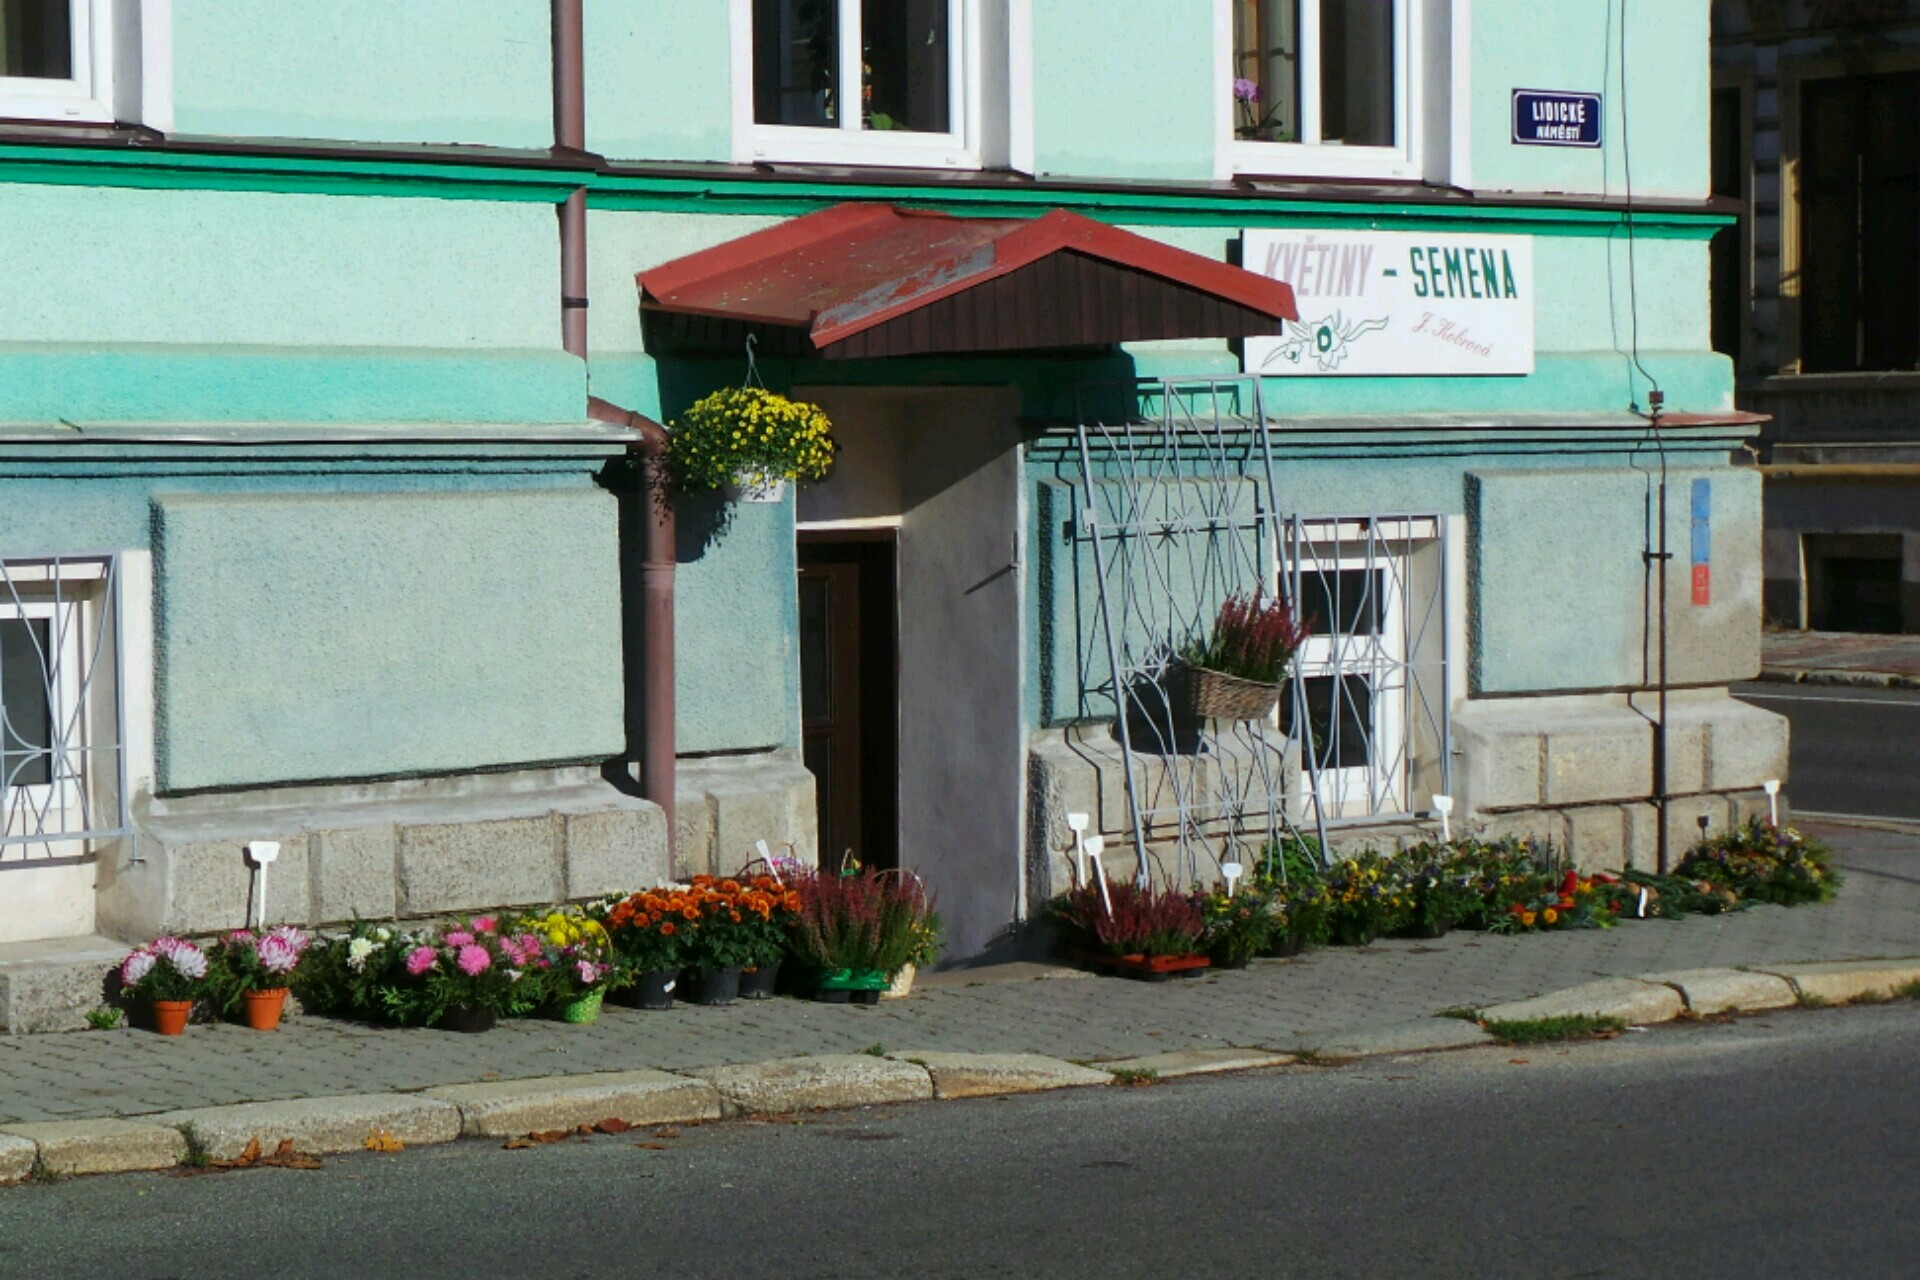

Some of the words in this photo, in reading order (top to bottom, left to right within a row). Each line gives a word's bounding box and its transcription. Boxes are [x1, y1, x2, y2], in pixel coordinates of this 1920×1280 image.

[1532, 99, 1585, 123] LIDICKÉ
[1264, 237, 1374, 297] KVĚTINY
[1410, 246, 1518, 299] SEMENA
